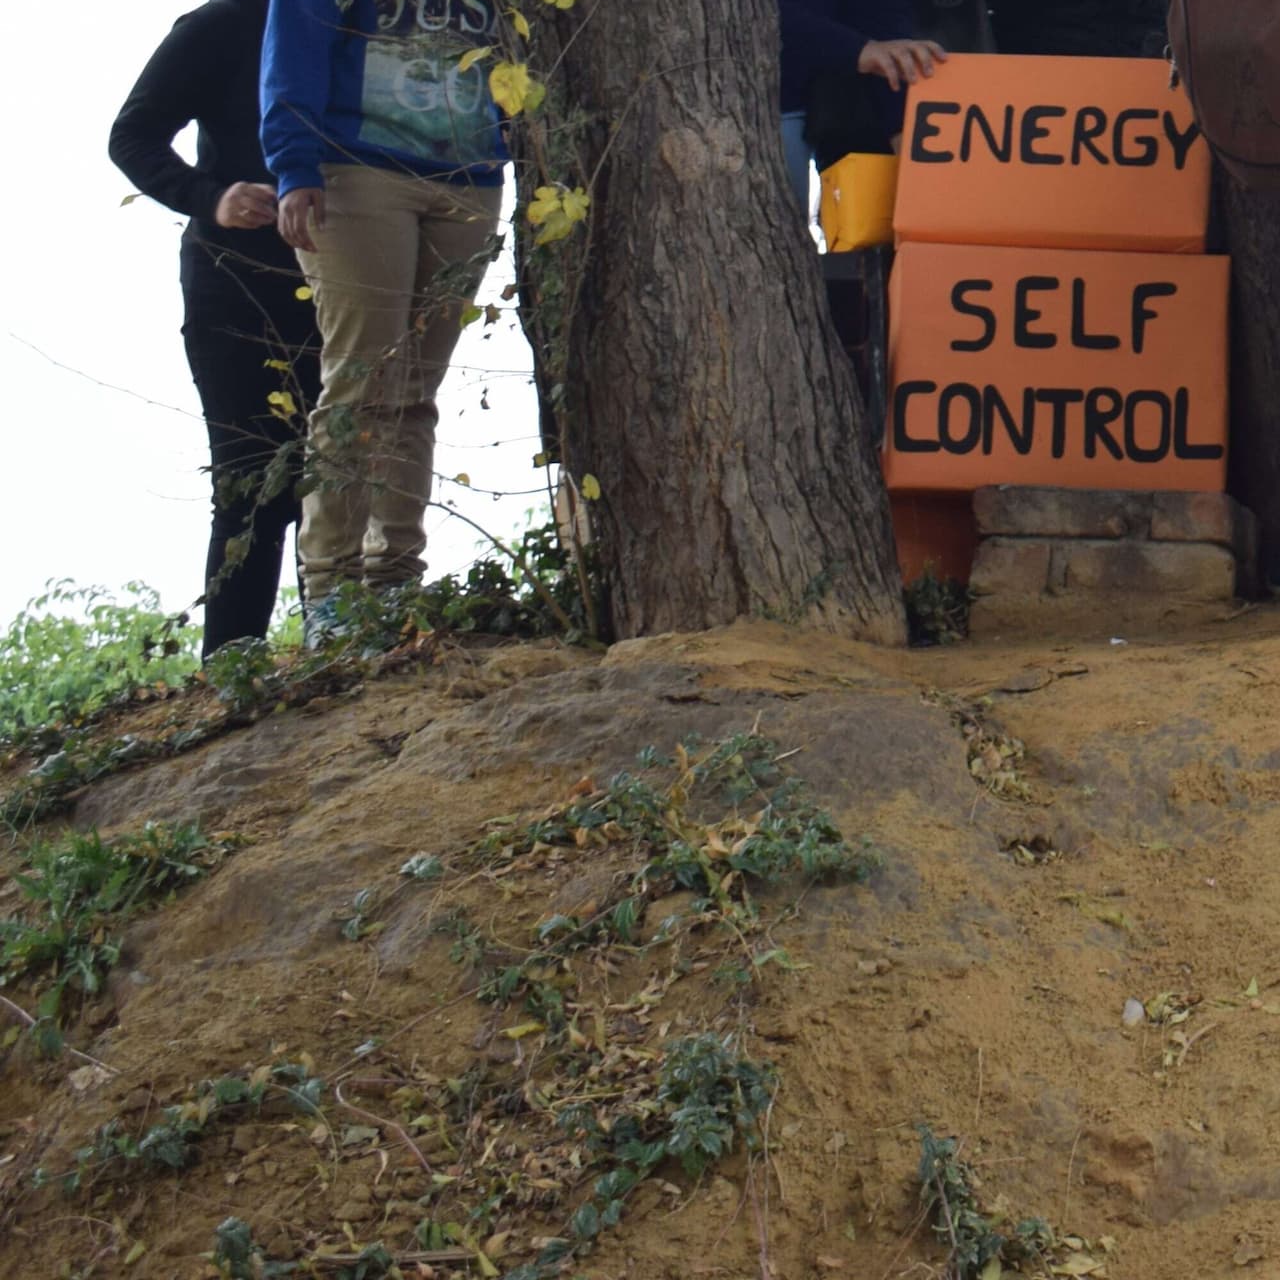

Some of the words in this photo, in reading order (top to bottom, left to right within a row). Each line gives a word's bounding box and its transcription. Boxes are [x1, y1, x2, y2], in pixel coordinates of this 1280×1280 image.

[392, 58, 482, 113] GO
[909, 101, 1201, 170] ENERGY
[950, 276, 1177, 354] SELF
[893, 380, 1223, 463] CONTROL
